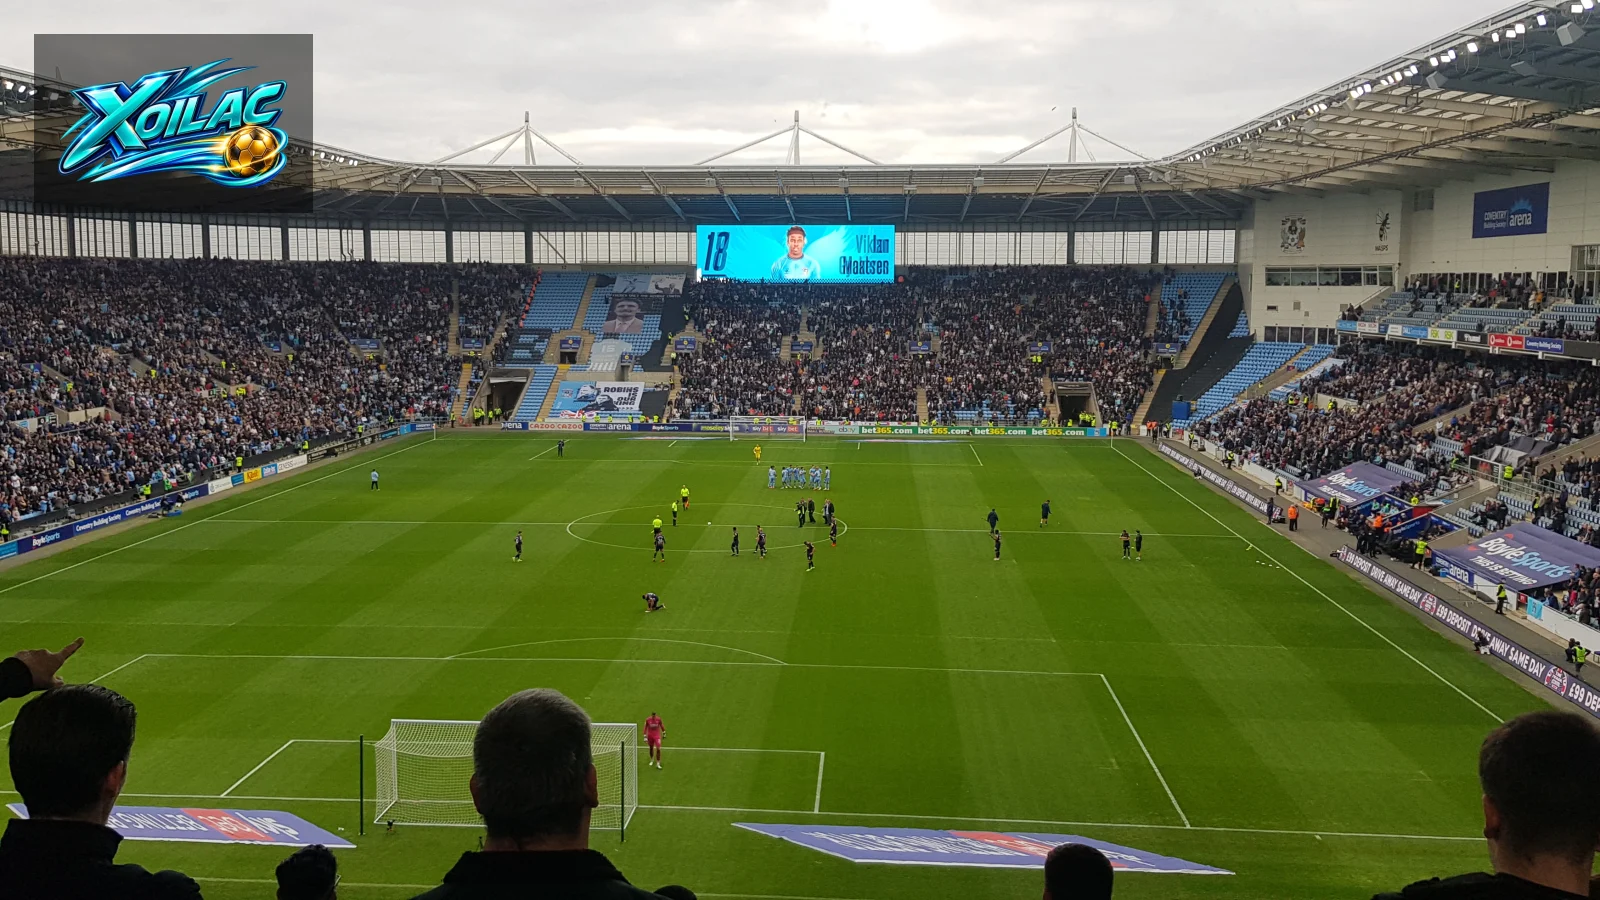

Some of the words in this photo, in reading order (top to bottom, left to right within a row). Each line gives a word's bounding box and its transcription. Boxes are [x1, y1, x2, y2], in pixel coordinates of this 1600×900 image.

[1509, 212, 1532, 227] arena
[704, 231, 730, 271] 18
[608, 422, 631, 431] arena
[861, 425, 913, 435] bet365.com
[974, 427, 1027, 436] bet365.com
[1031, 427, 1084, 437] bet365.com
[1327, 472, 1381, 497] BoyleSports
[126, 505, 141, 516] Coventry
[75, 521, 93, 532] Coventry
[93, 516, 109, 527] Building
[108, 512, 122, 522] Society
[32, 531, 61, 547] BoyleSports
[1478, 537, 1572, 578] BoyleSports
[1345, 551, 1355, 565] £99
[1353, 554, 1372, 574] DEPOSIT
[1370, 565, 1385, 582] DRIVE
[1382, 573, 1399, 590] AWAY
[1396, 580, 1412, 598] SAME
[1408, 588, 1422, 603] DAY
[1449, 563, 1470, 584] arena
[1469, 555, 1494, 568] THIS
[1498, 567, 1538, 586] BETTING
[1435, 604, 1448, 620] £99
[1446, 610, 1471, 634] DEPOSIT
[1489, 636, 1511, 657] AWAY
[1508, 646, 1531, 667] SAME
[1527, 656, 1546, 678] DAY
[1568, 682, 1586, 703] £99
